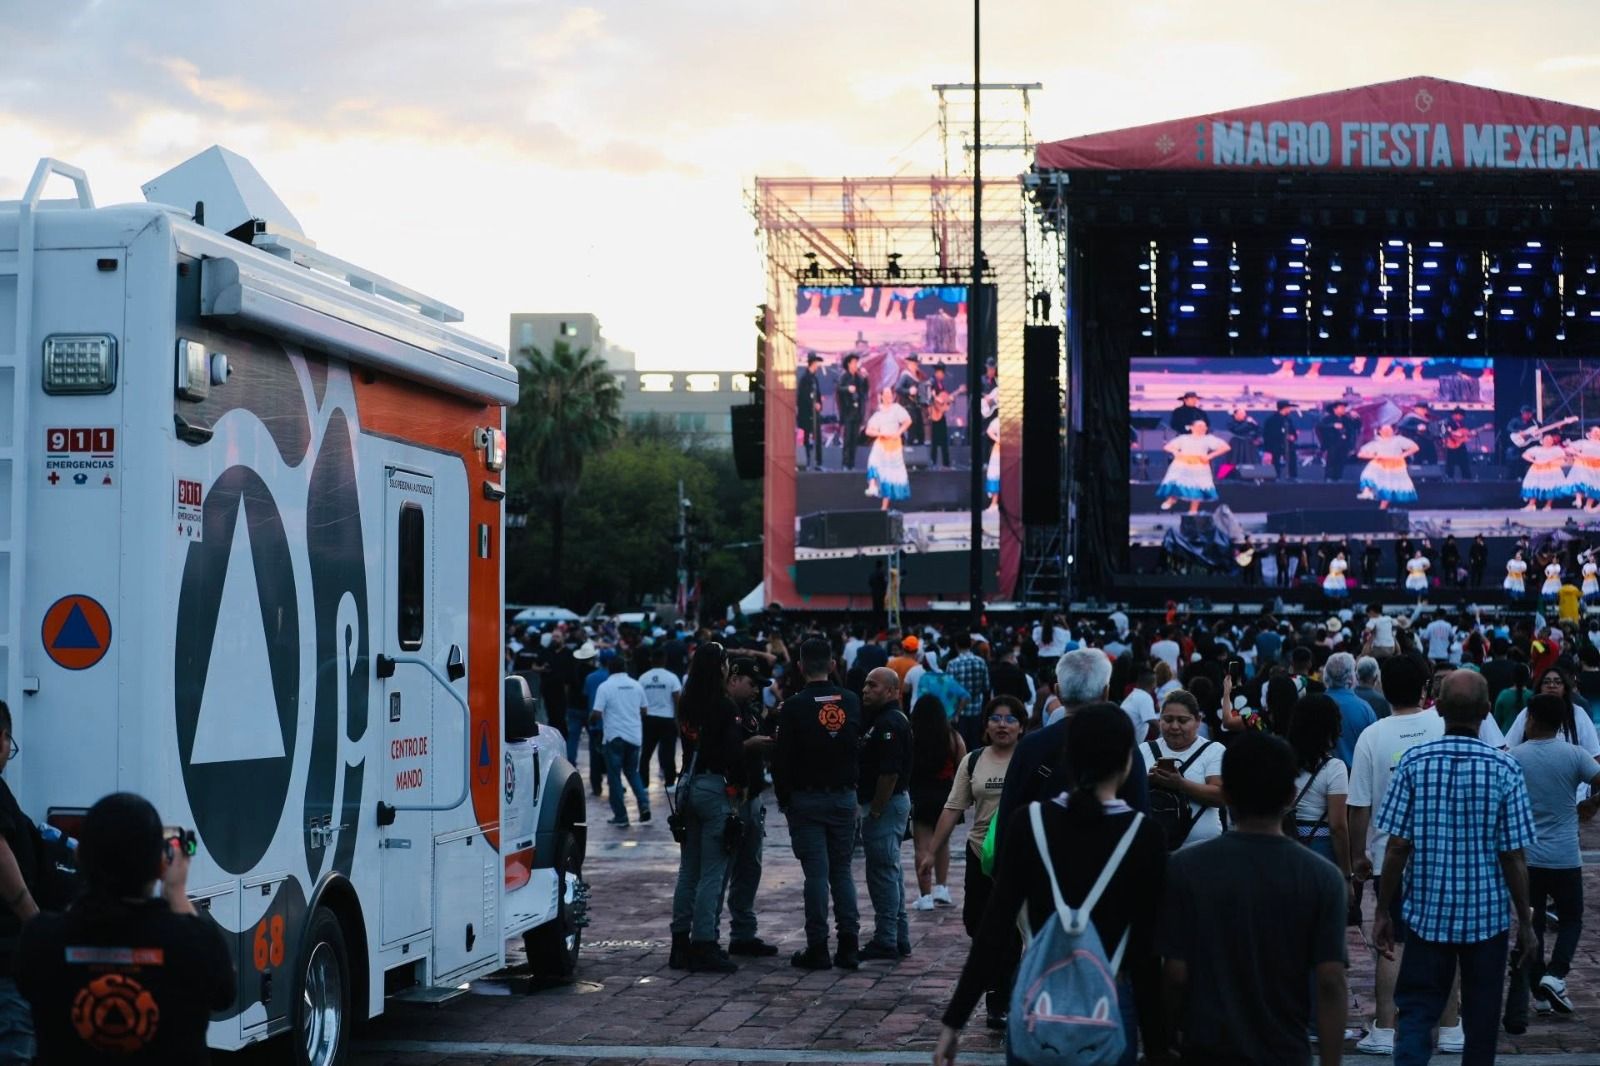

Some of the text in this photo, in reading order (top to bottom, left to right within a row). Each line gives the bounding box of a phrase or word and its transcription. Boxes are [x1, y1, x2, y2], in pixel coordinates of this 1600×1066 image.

[1212, 121, 1331, 167] MACRO
[50, 430, 110, 451] 911
[46, 460, 114, 469] EMERGENCIAS
[179, 482, 201, 505] 911
[391, 736, 428, 760] CENTRO DE
[396, 768, 423, 791] MANDO
[253, 914, 285, 972] 68
